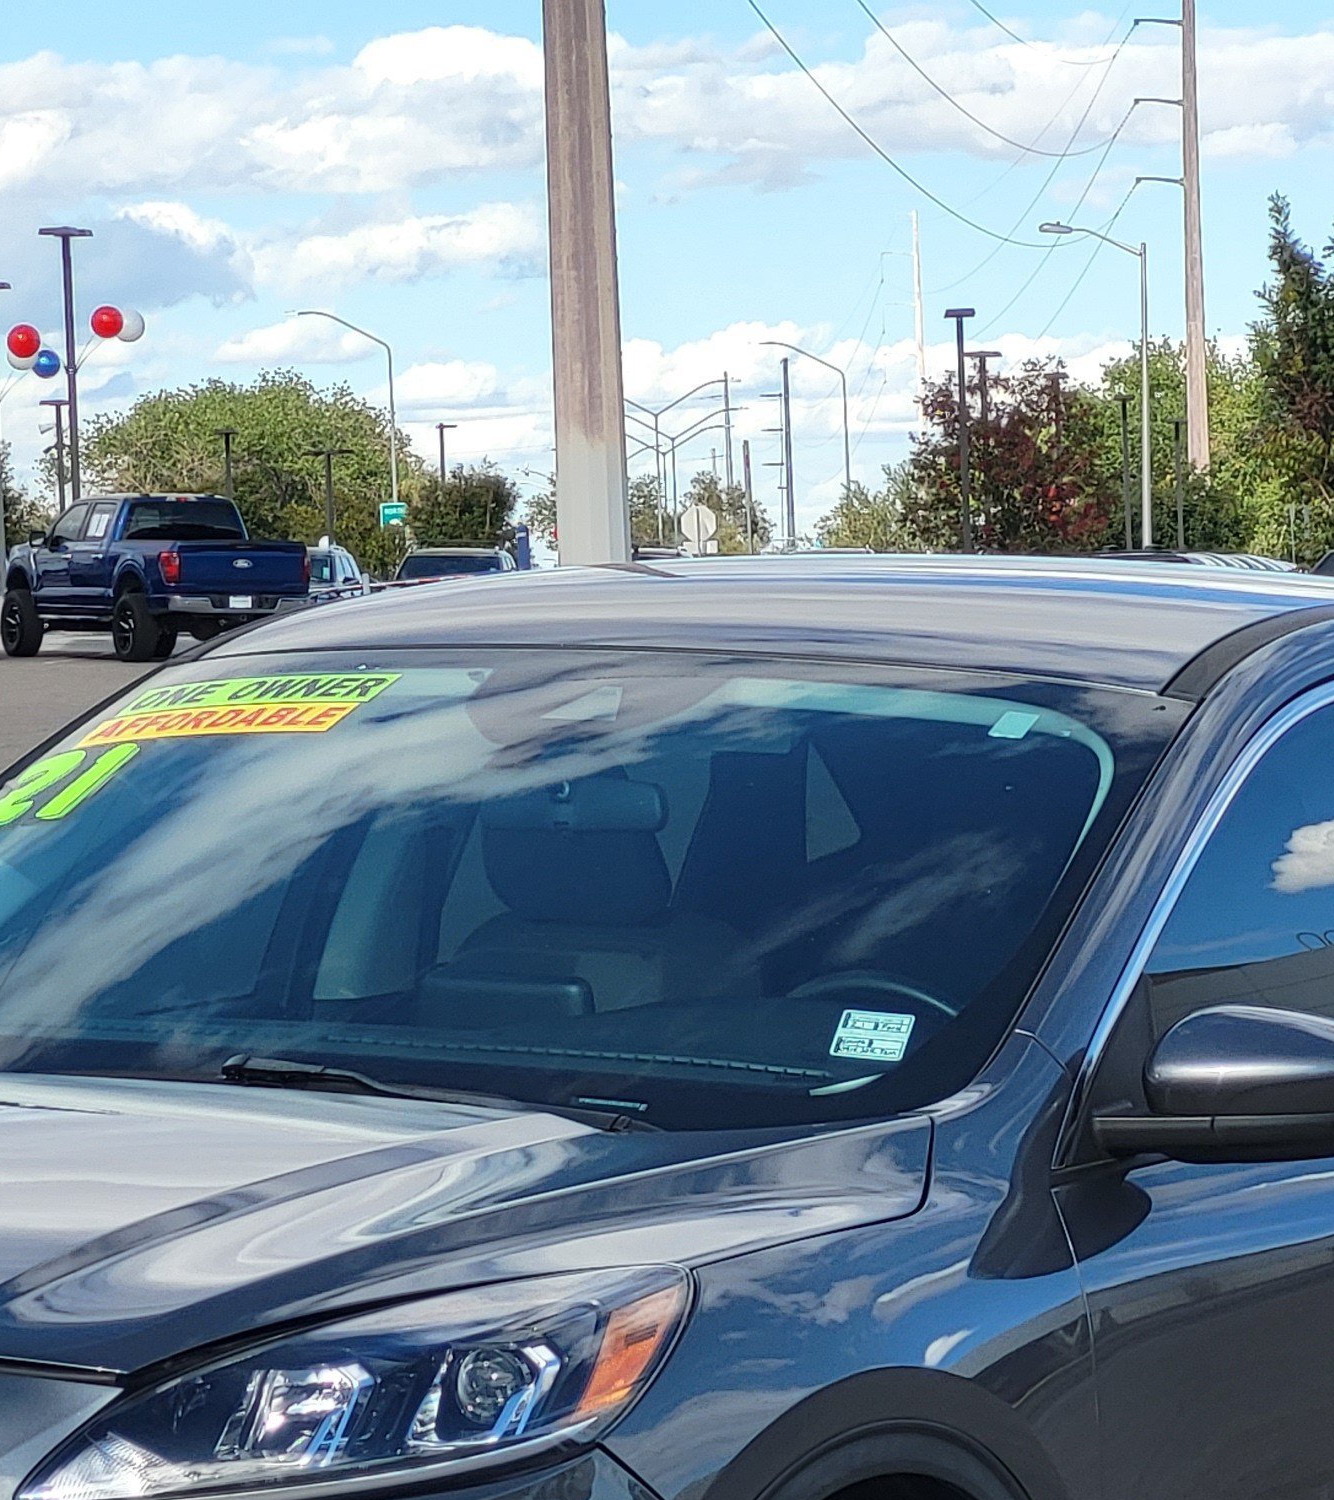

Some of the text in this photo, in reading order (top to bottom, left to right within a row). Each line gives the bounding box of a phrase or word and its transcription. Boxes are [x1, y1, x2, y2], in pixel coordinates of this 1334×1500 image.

[131, 677, 390, 711] ONE OWNER
[91, 706, 347, 740] AFFORDABLE
